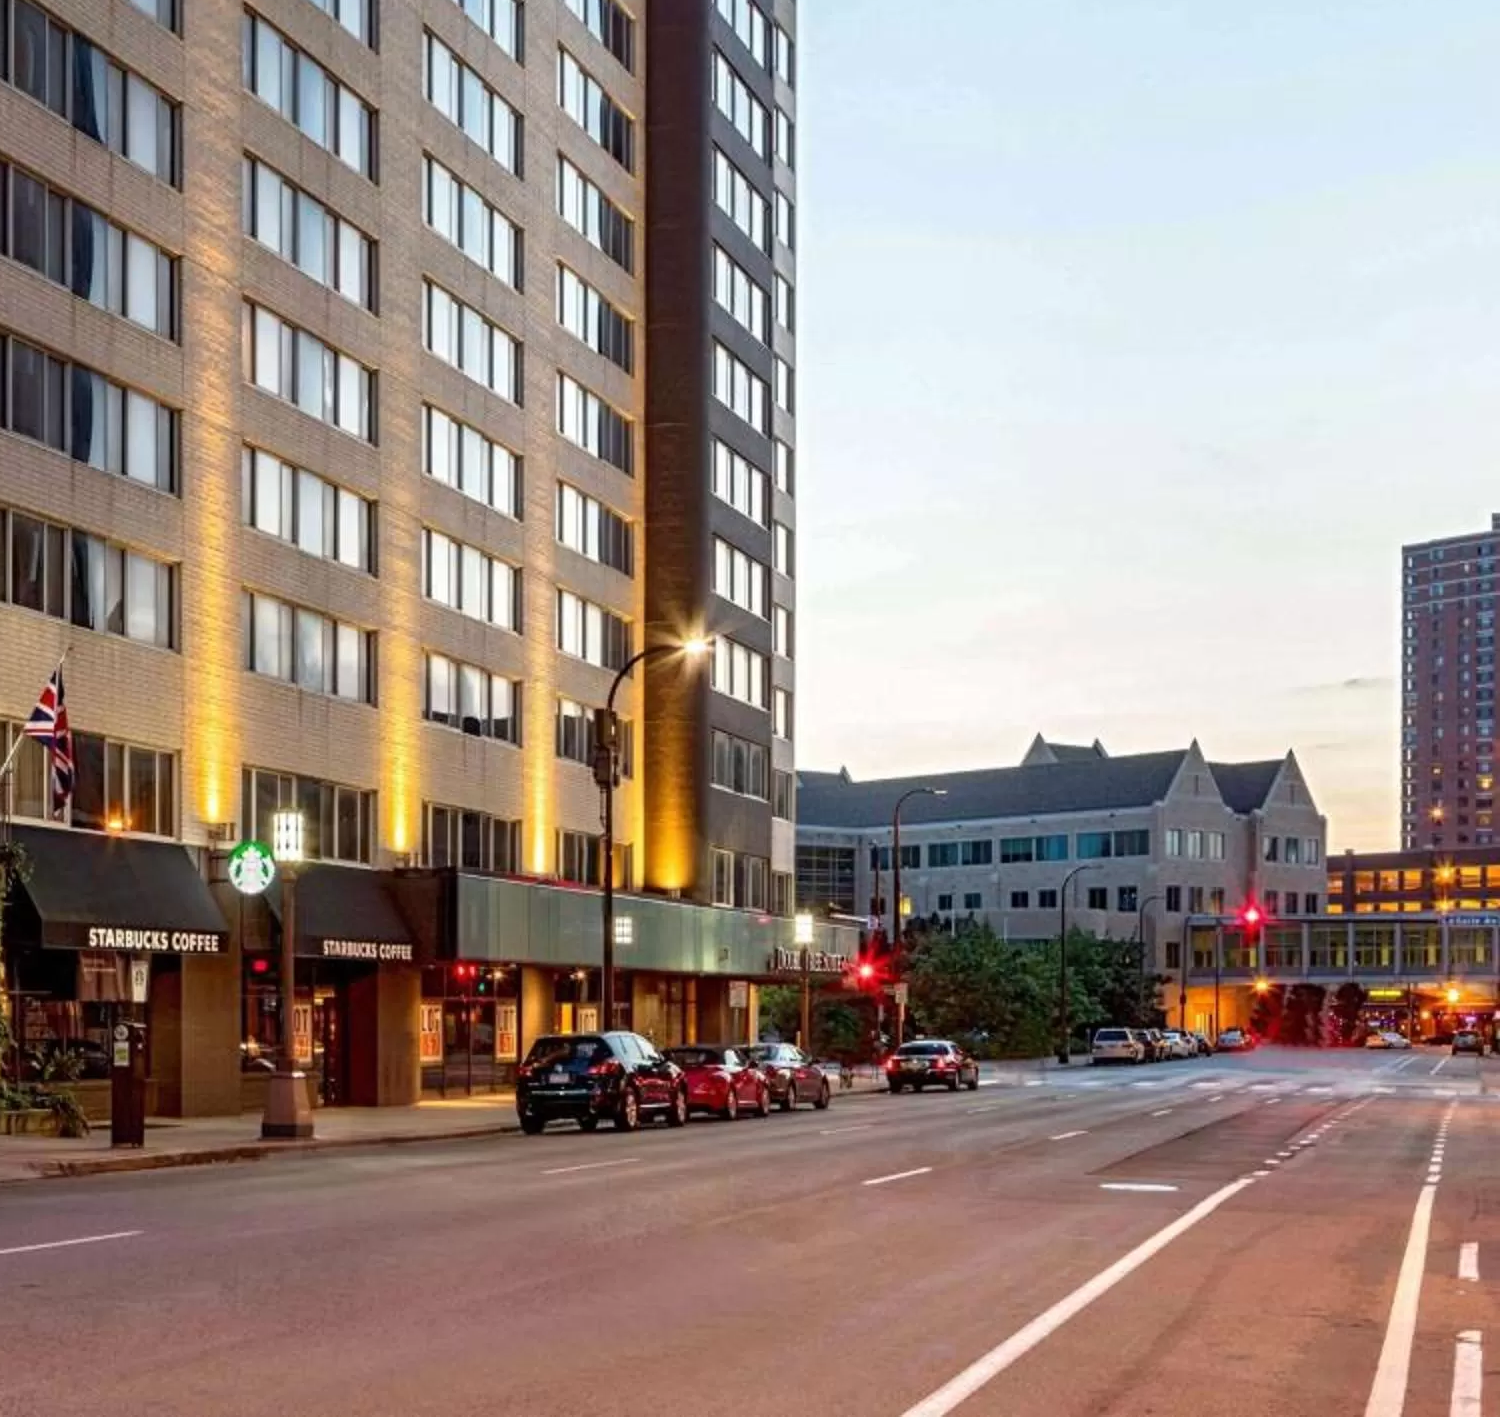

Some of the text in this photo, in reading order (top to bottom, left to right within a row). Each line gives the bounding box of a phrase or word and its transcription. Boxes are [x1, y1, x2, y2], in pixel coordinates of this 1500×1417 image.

[89, 926, 219, 952] STARBUCKS COFFEE
[323, 939, 413, 960] STARBUCKS COFFEE
